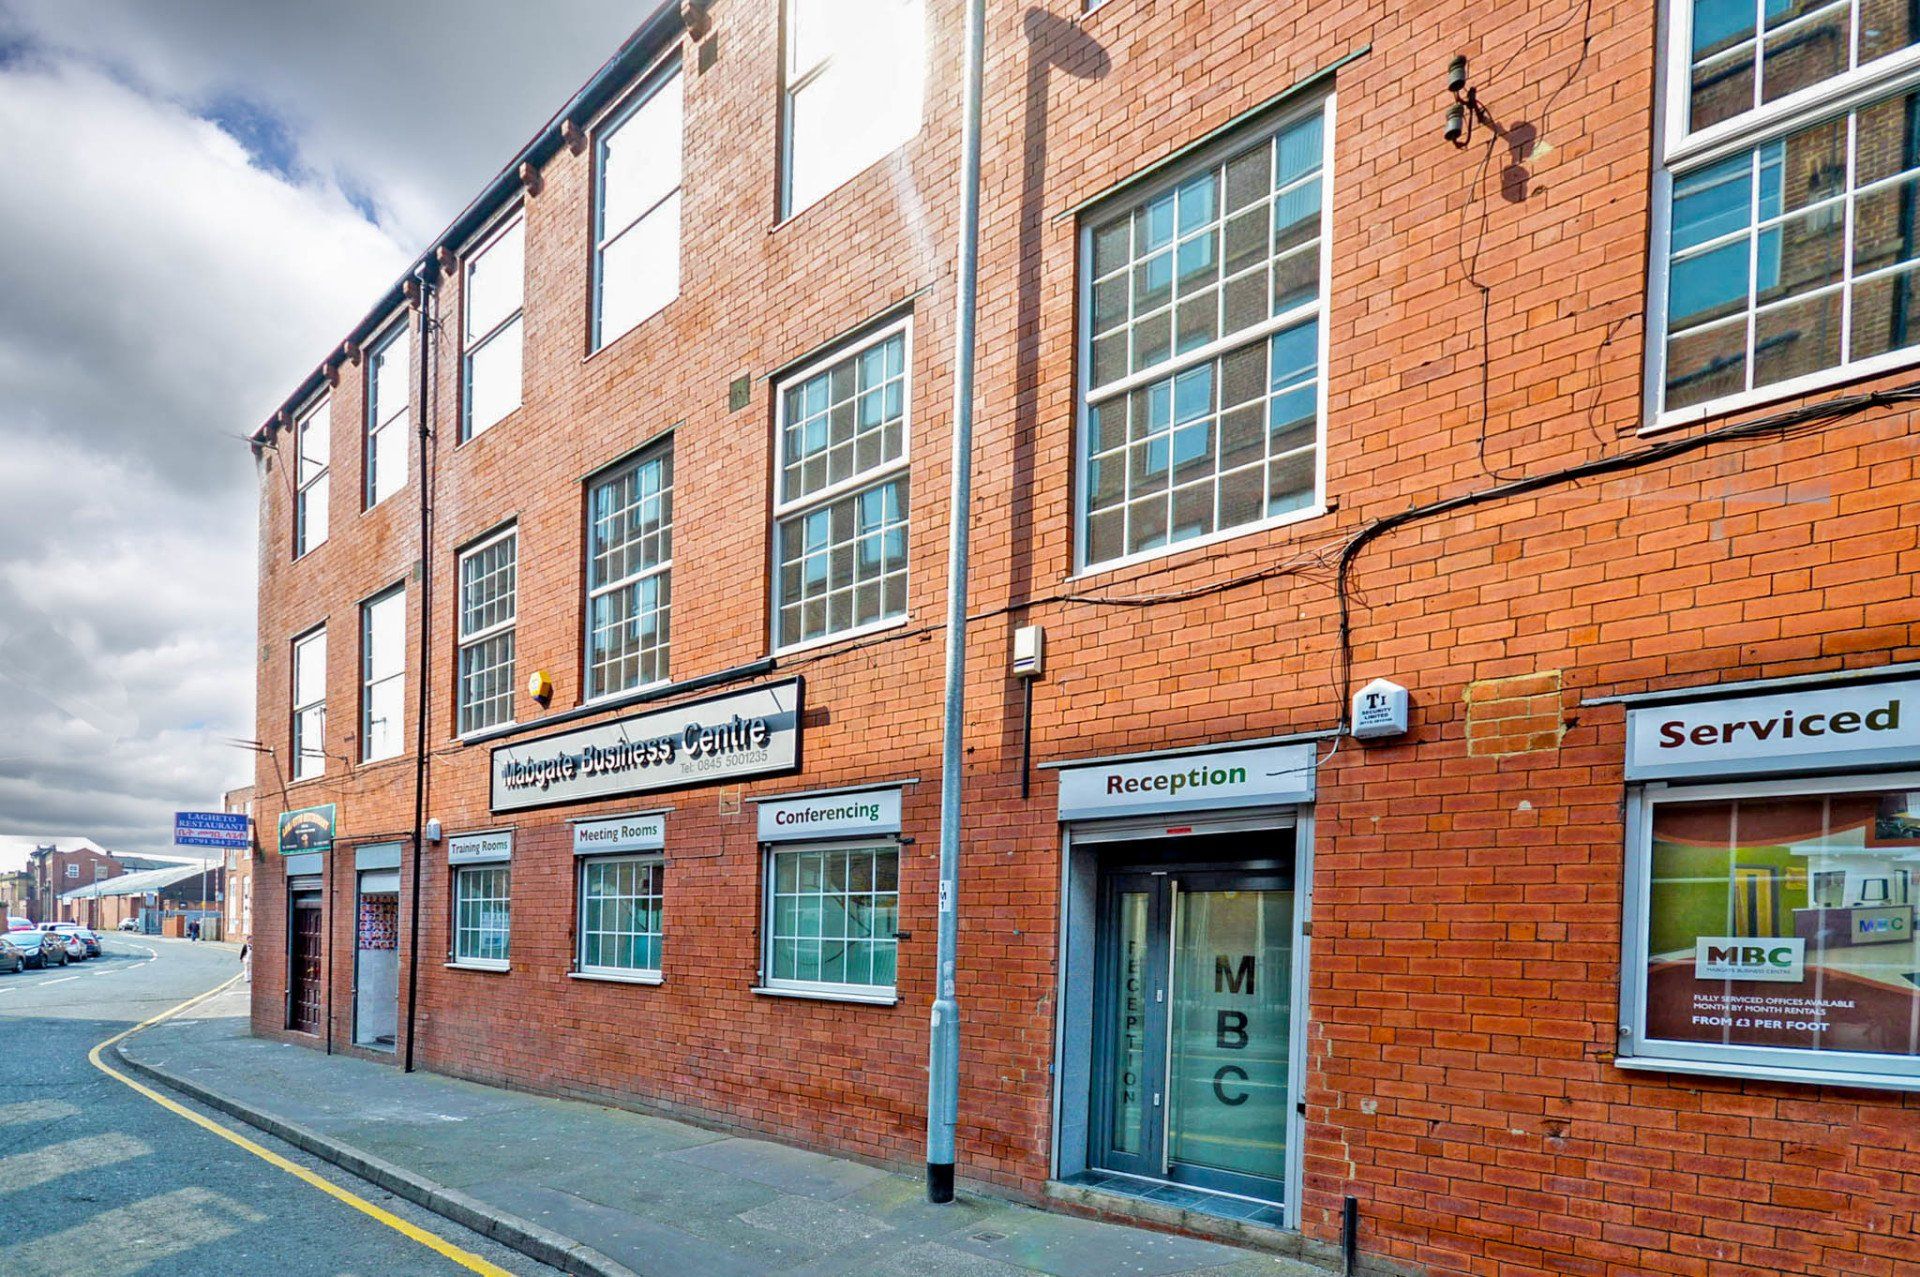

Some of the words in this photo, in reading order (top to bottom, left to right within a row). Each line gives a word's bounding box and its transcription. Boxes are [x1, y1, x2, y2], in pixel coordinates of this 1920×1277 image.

[1362, 707, 1391, 715] SECURITY
[1659, 700, 1900, 749] Serviced
[504, 754, 575, 790] Mabgate
[580, 734, 673, 773] Business
[681, 714, 771, 755] Centre
[697, 758, 721, 772] 0845
[726, 750, 768, 767] 5001235
[1106, 766, 1247, 795] Reception
[776, 803, 879, 825] Conferencing
[179, 820, 245, 831] RESTAURANT
[579, 828, 618, 842] Meeting
[621, 825, 658, 838] Rooms
[451, 842, 480, 855] Training
[482, 840, 508, 851] Rooms
[1707, 946, 1792, 968] MBC
[1693, 994, 1719, 1002] FULLY
[1721, 995, 1763, 1004] SERVICED
[1765, 998, 1803, 1006] OFFICES
[1804, 999, 1855, 1008] AVAILABLE
[1693, 1003, 1729, 1011] MONTH
[1731, 1004, 1742, 1012] BY
[1784, 1007, 1826, 1016] RENTALS
[1692, 1016, 1732, 1026] FROM
[1736, 1018, 1750, 1028] £3
[1754, 1020, 1782, 1030] PER
[1786, 1021, 1830, 1032] FOOT
